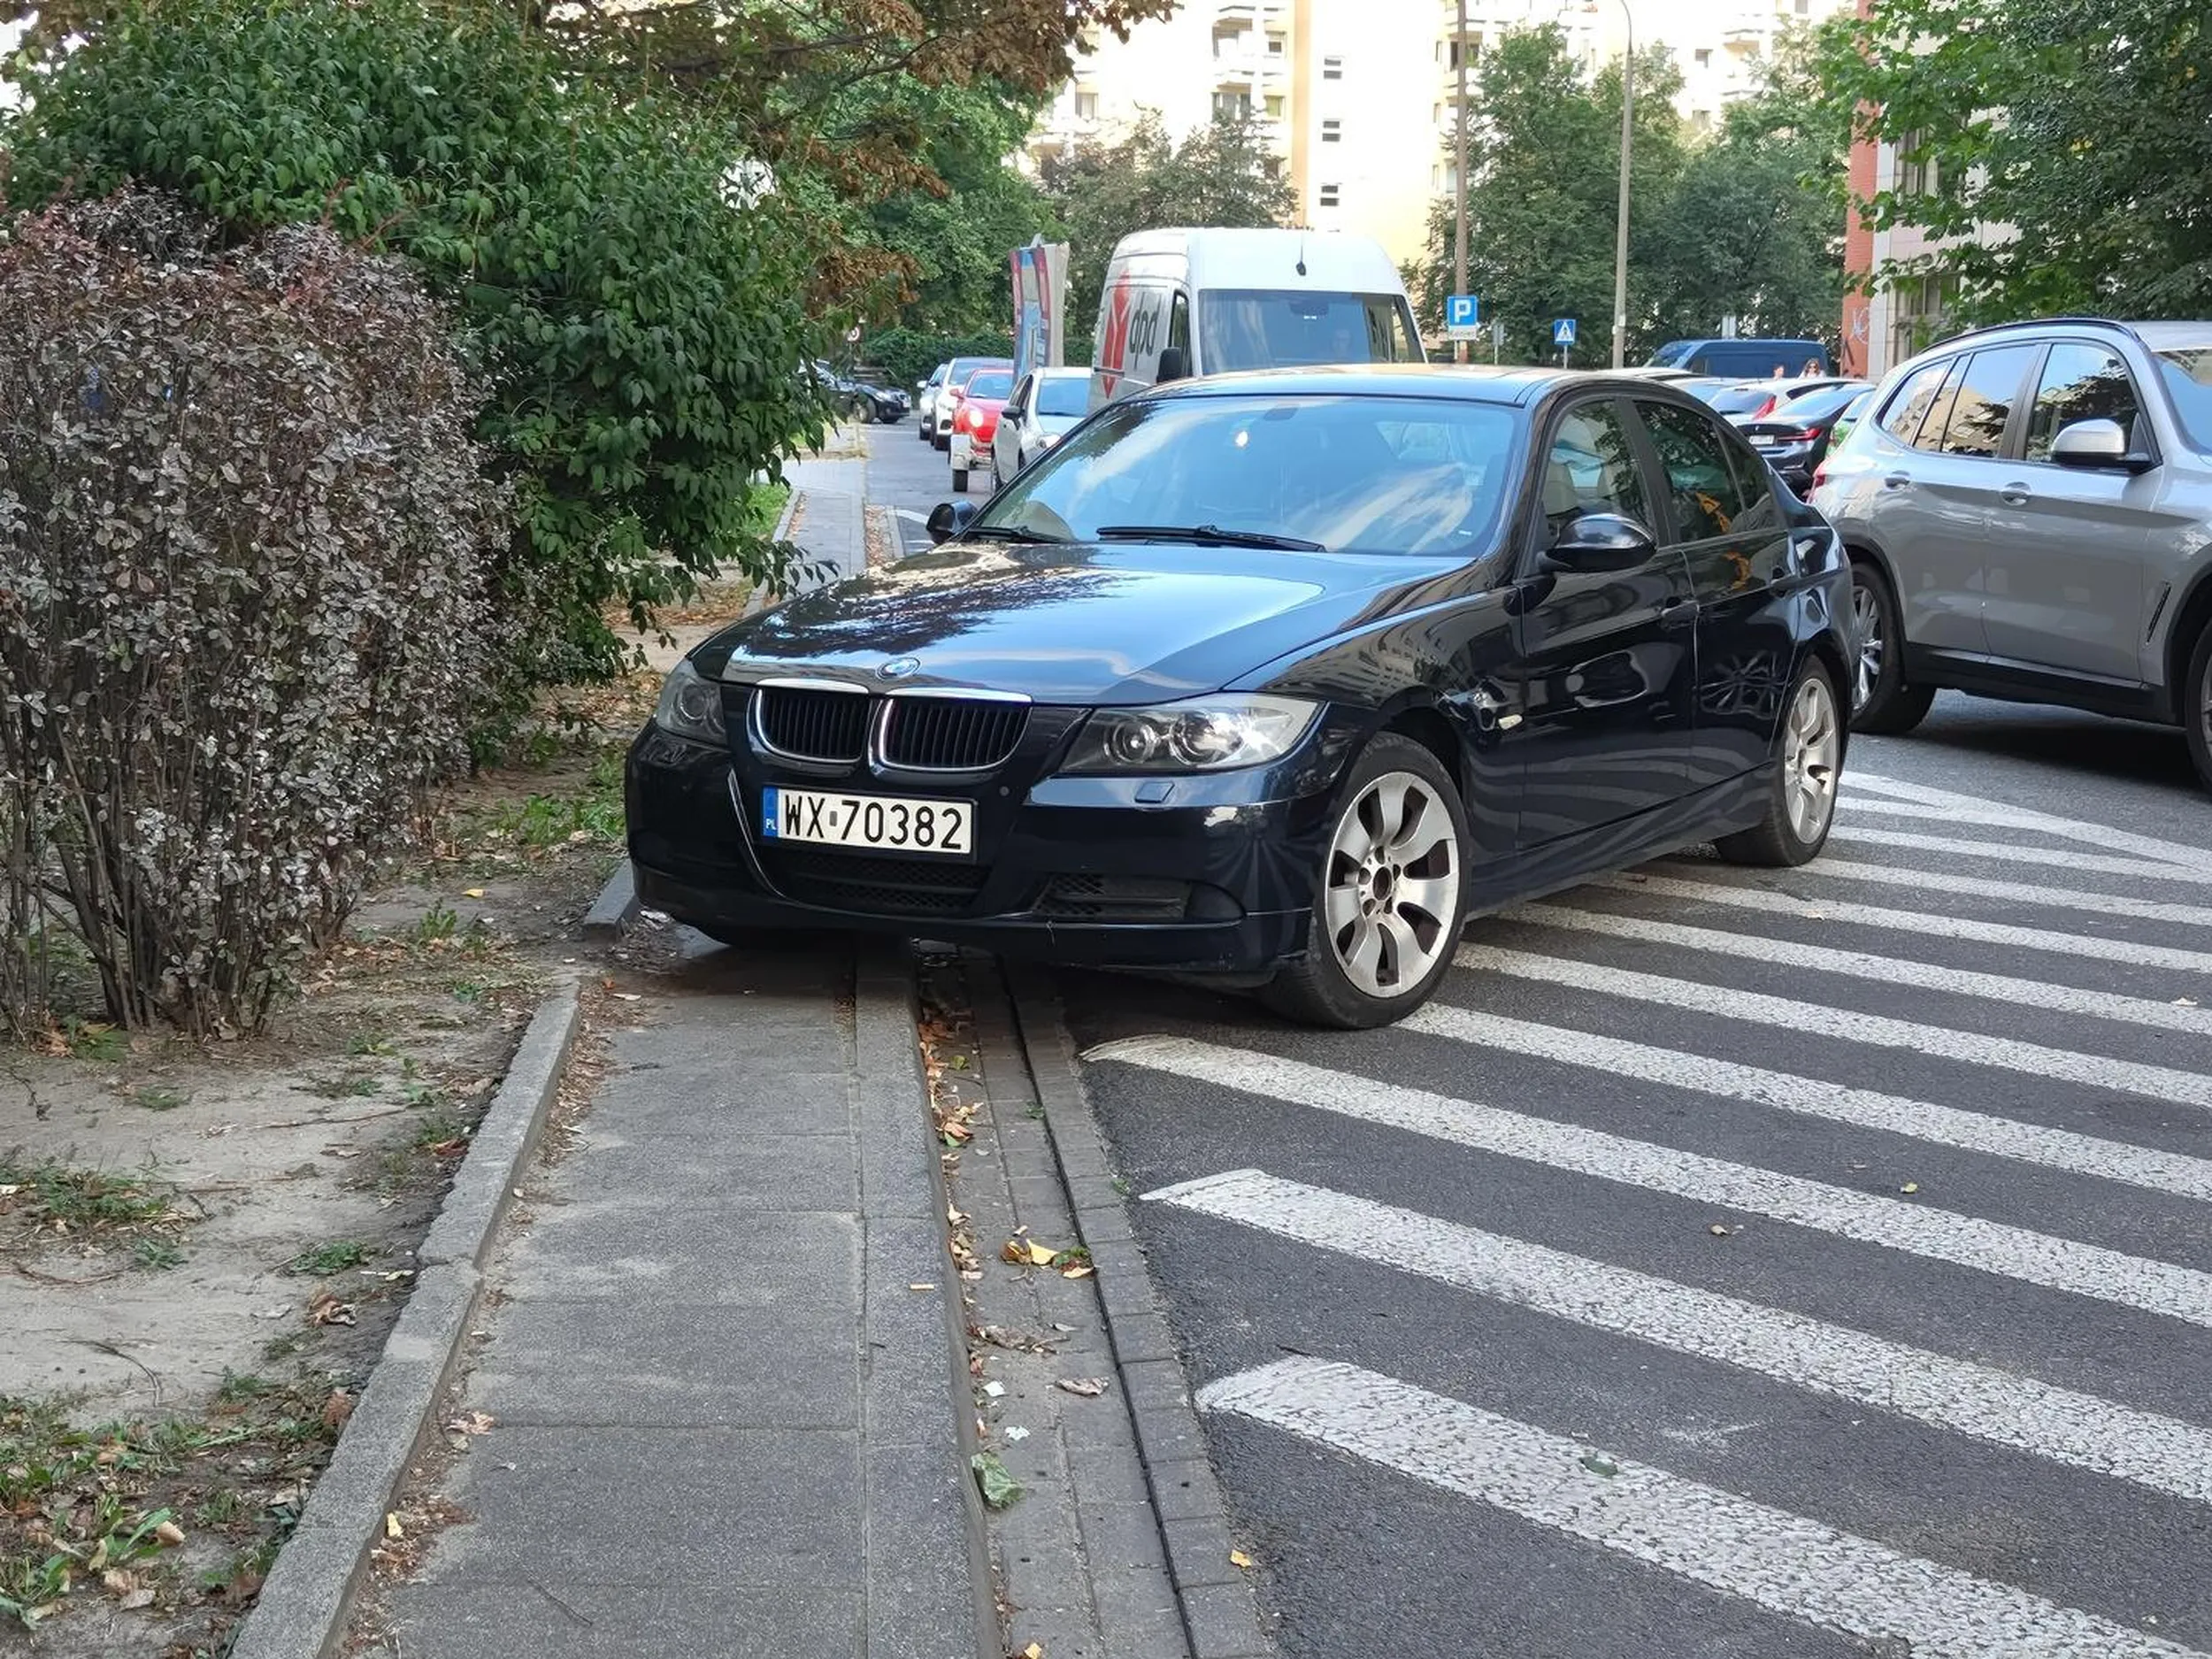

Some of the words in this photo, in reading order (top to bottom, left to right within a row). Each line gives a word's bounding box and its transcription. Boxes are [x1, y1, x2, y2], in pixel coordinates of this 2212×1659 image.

[1454, 299, 1471, 323] P
[1129, 292, 1161, 370] dpd
[765, 818, 777, 830] PL
[785, 795, 826, 839] WX
[841, 799, 963, 850] 70382
